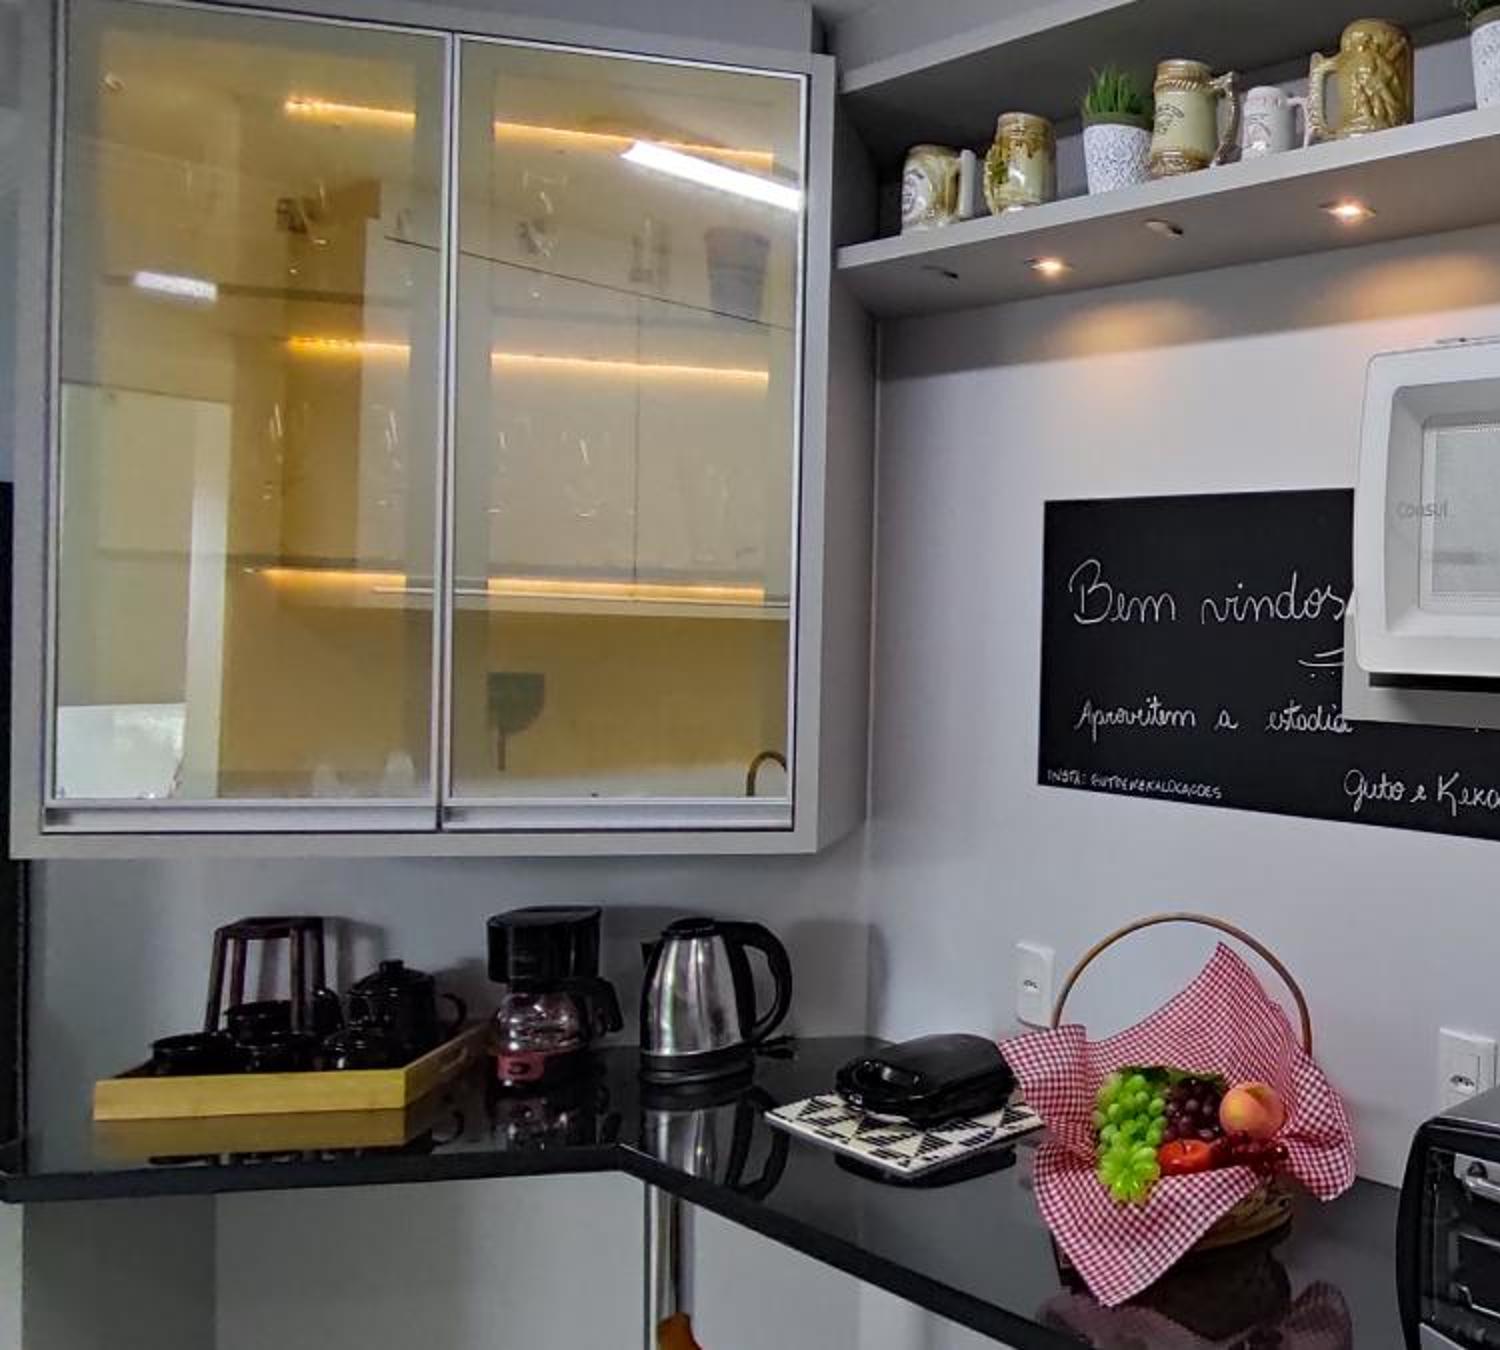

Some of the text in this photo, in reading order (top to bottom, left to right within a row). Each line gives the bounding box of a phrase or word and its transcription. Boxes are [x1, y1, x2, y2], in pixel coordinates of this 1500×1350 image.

[1069, 559, 1345, 624] Bem vindos
[1073, 696, 1353, 743] Aproveitem a estadia
[1343, 768, 1406, 813] Guto
[1410, 784, 1427, 803] e
